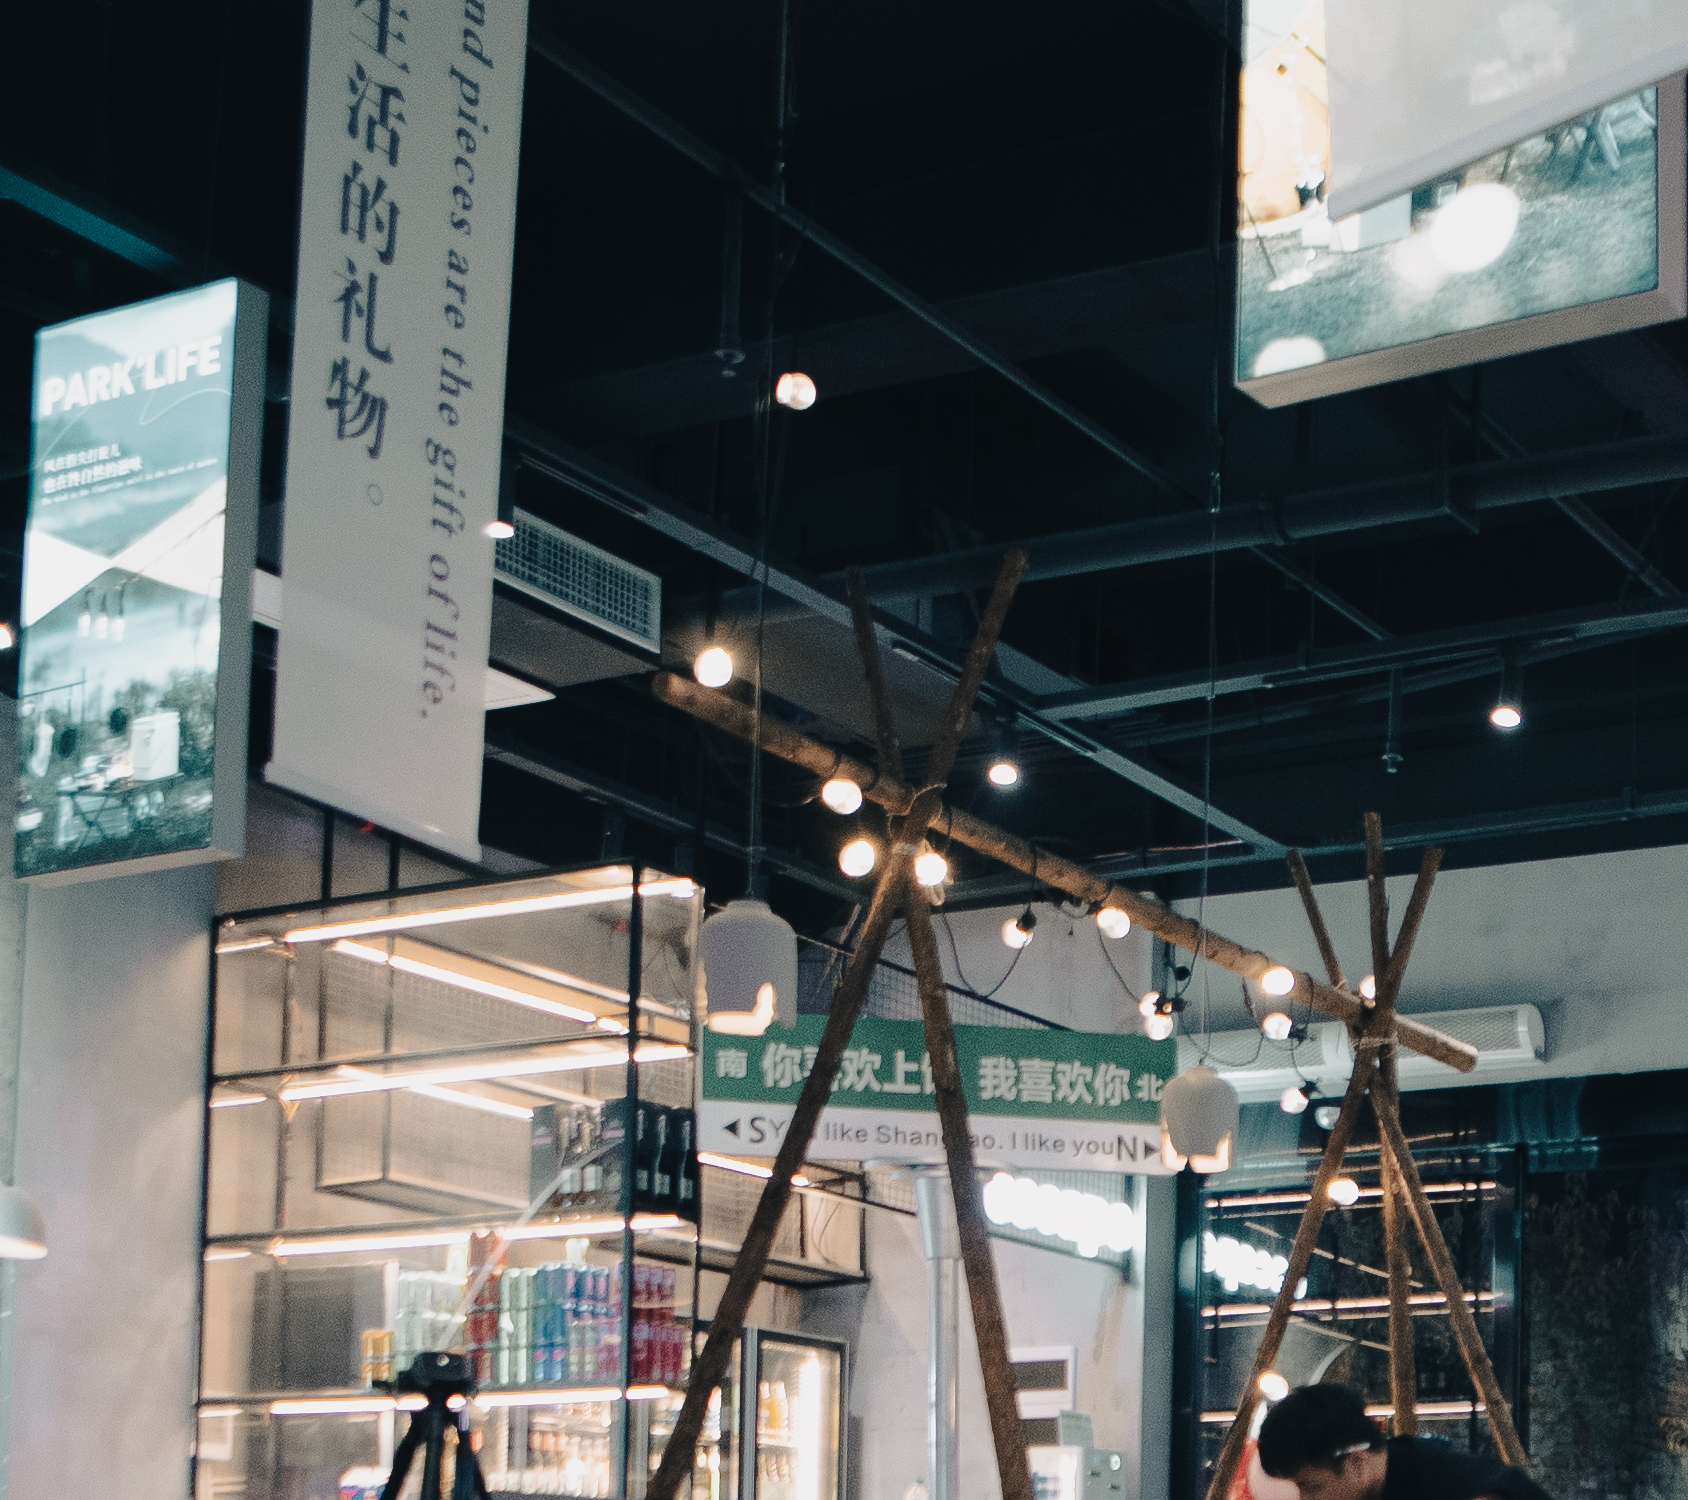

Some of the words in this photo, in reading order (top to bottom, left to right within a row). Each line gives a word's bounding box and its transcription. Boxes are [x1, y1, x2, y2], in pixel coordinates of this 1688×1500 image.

[449, 64, 490, 237] pieces
[443, 247, 471, 330] are
[39, 335, 222, 416] PARK'LIFE
[438, 346, 473, 428] the
[425, 436, 467, 539] gift
[427, 553, 460, 621] of
[420, 617, 459, 718] life.
[715, 1048, 748, 1079] 南
[978, 1055, 1132, 1107] 我喜欢你
[1136, 1072, 1165, 1102] 北
[824, 1121, 868, 1143] like
[876, 1123, 1003, 1150] Shanao.
[1024, 1131, 1066, 1153] like
